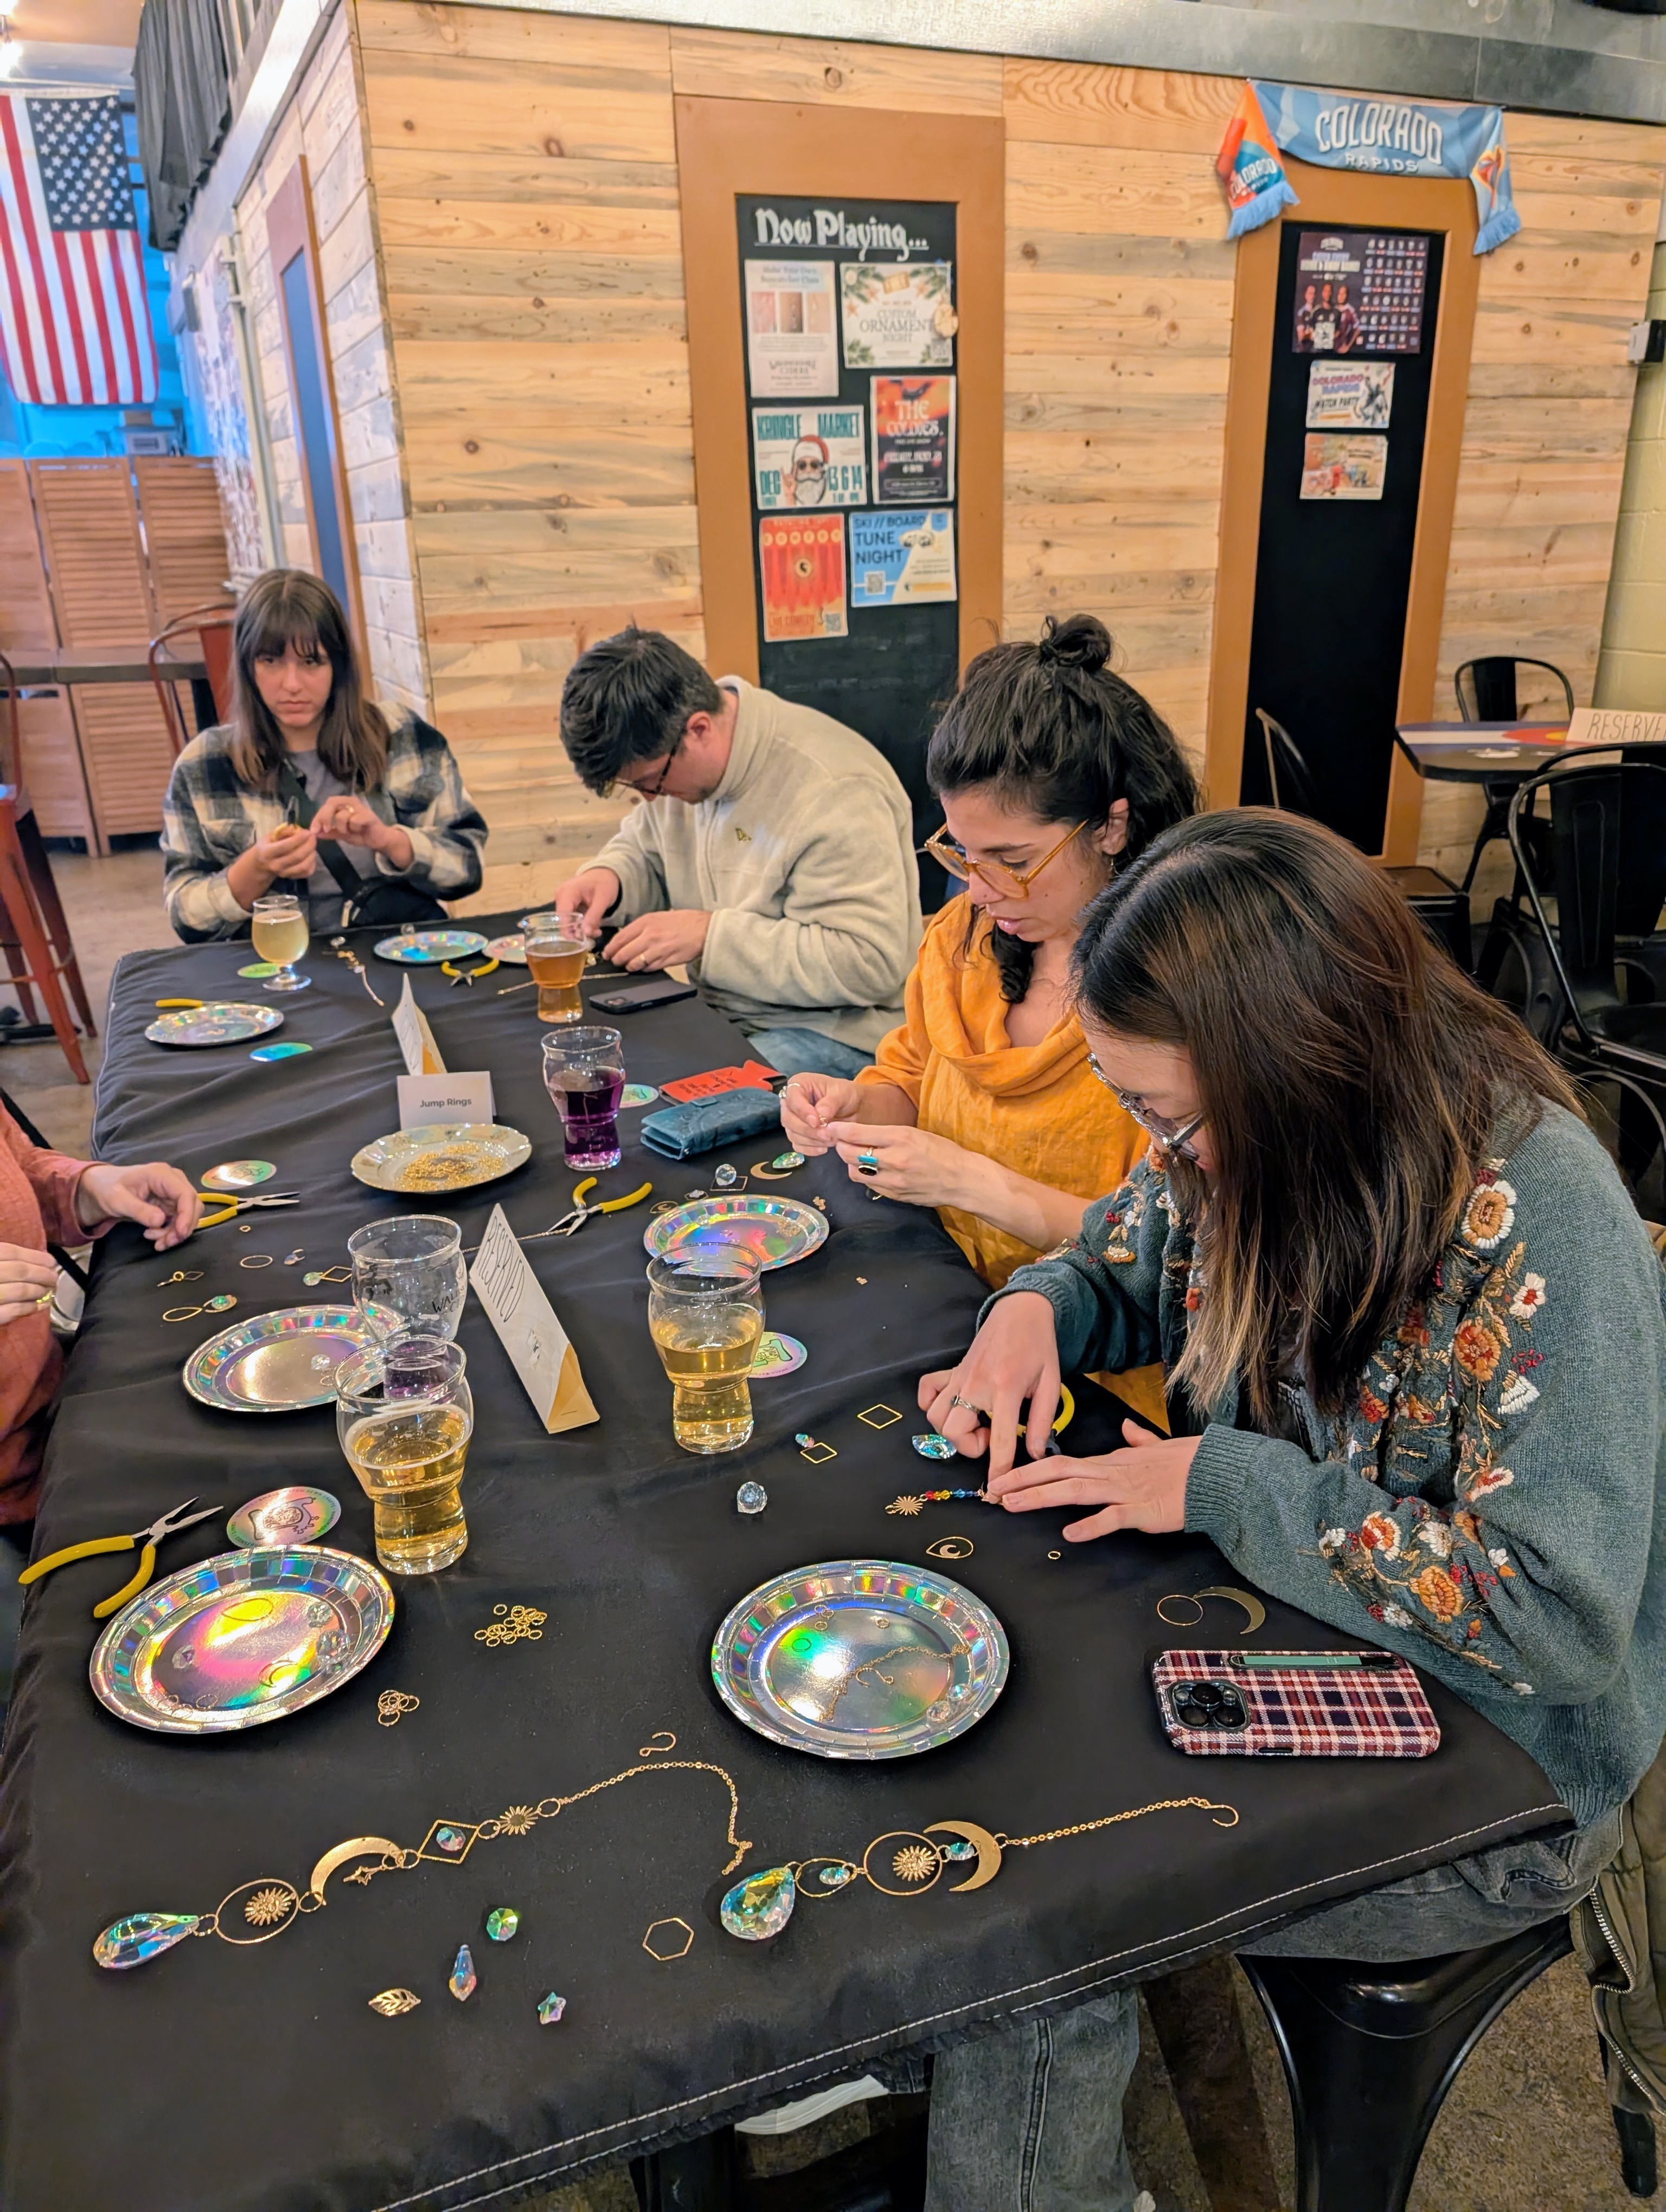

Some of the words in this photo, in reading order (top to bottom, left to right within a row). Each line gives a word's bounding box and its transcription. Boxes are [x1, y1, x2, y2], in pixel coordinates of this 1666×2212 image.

[1315, 102, 1443, 165] COLORADO
[1345, 151, 1419, 172] RAPIDS
[813, 209, 928, 262] Playing...
[876, 309, 917, 319] CUSTOM
[859, 319, 934, 332] ORNAMENT
[882, 333, 912, 343] NIGHT
[895, 400, 930, 420] THE
[757, 413, 802, 441] KRINGLE
[818, 413, 860, 439] MARKET
[760, 470, 781, 496] DEC
[855, 518, 872, 529] SKI
[886, 515, 926, 527] BOARD
[855, 531, 895, 546] TUNE
[855, 549, 903, 565] NIGHT
[1586, 712, 1666, 742] RESERVE
[420, 1099, 445, 1108] Jump
[446, 1097, 472, 1107] Rings
[476, 1215, 525, 1323] RESERVED
